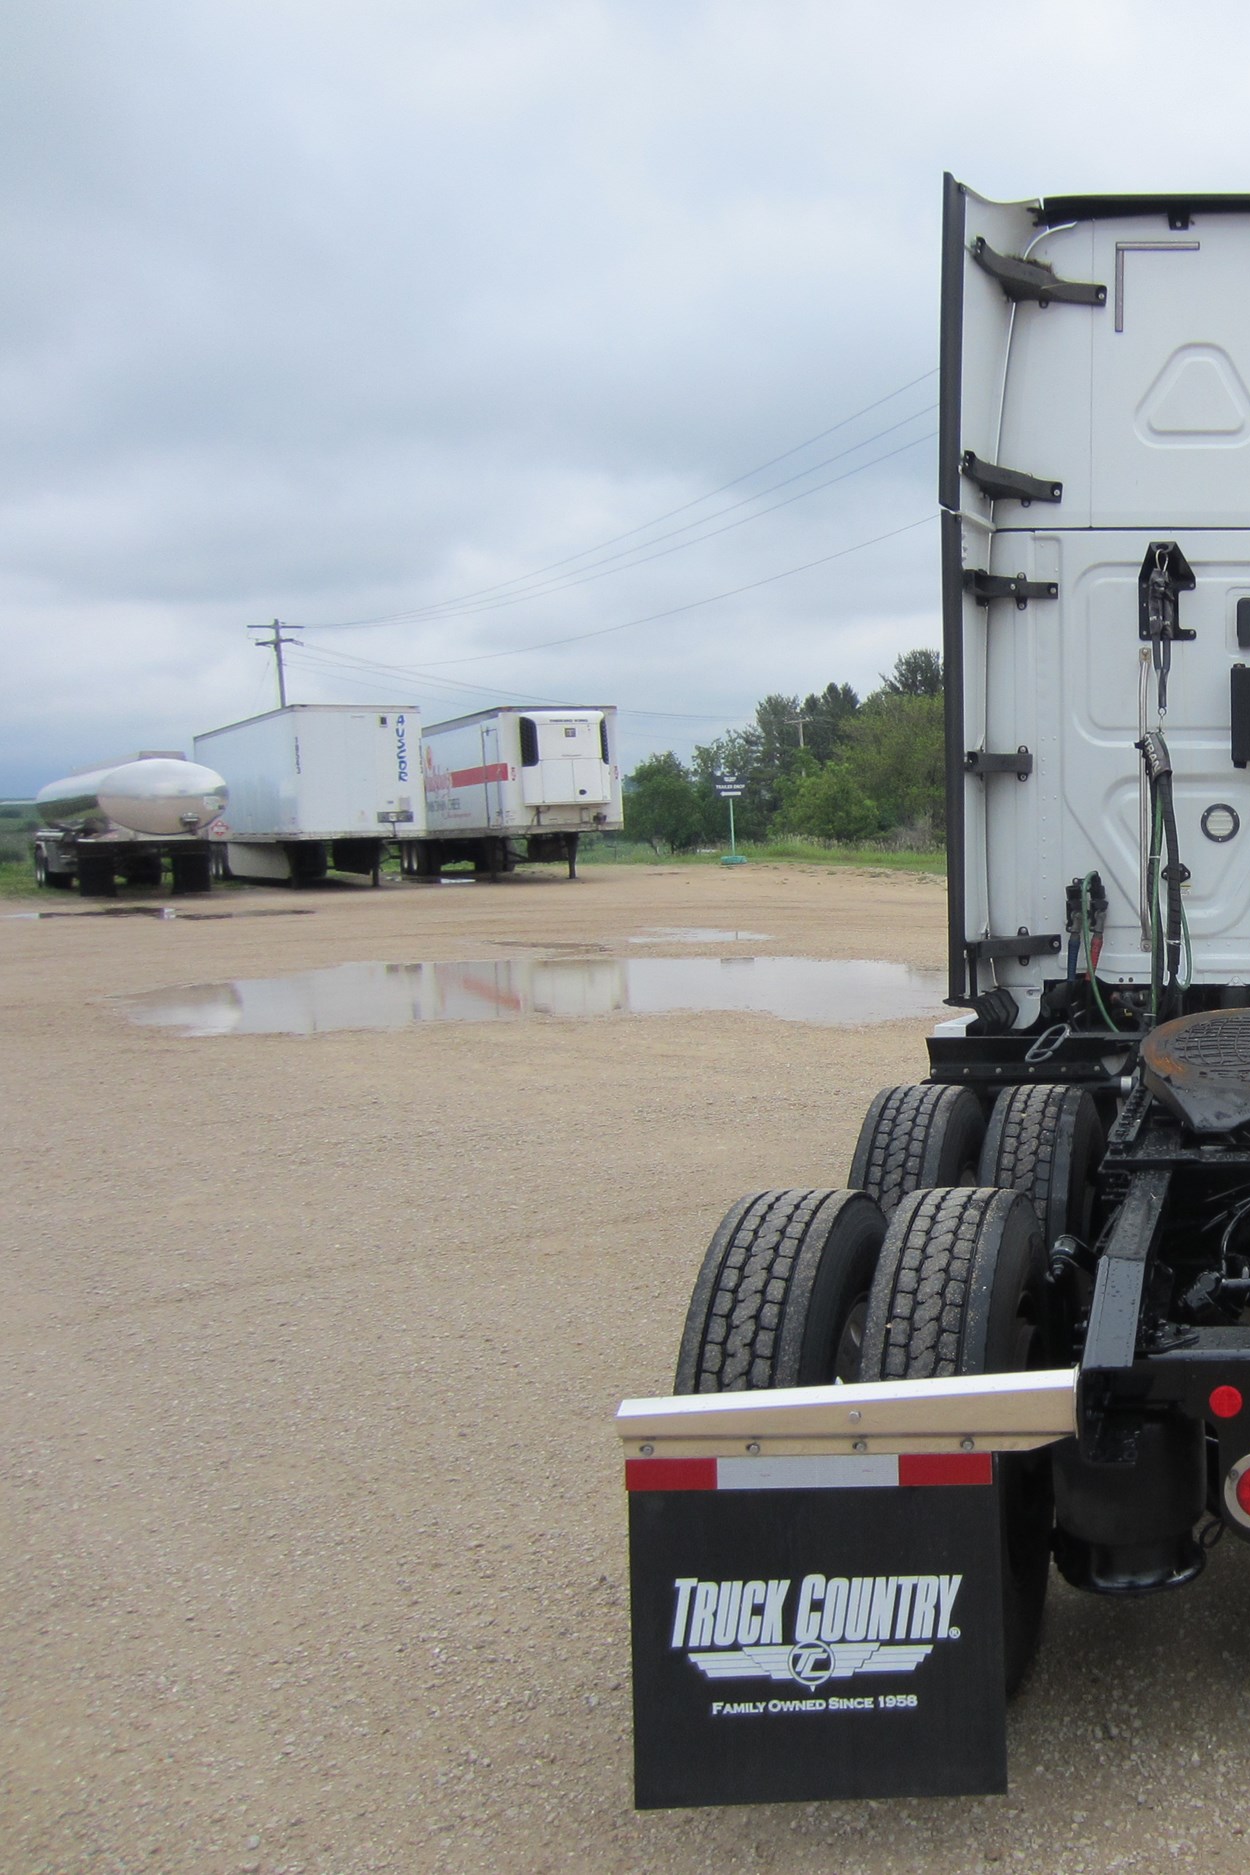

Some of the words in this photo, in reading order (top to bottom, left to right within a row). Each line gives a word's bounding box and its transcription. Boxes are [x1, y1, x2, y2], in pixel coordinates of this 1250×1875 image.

[671, 1577, 791, 1648] TRUCK
[712, 1700, 767, 1715] FAMILY
[767, 1698, 827, 1713] OWNED
[828, 1697, 875, 1711] SINCE
[877, 1695, 918, 1708] 1958
